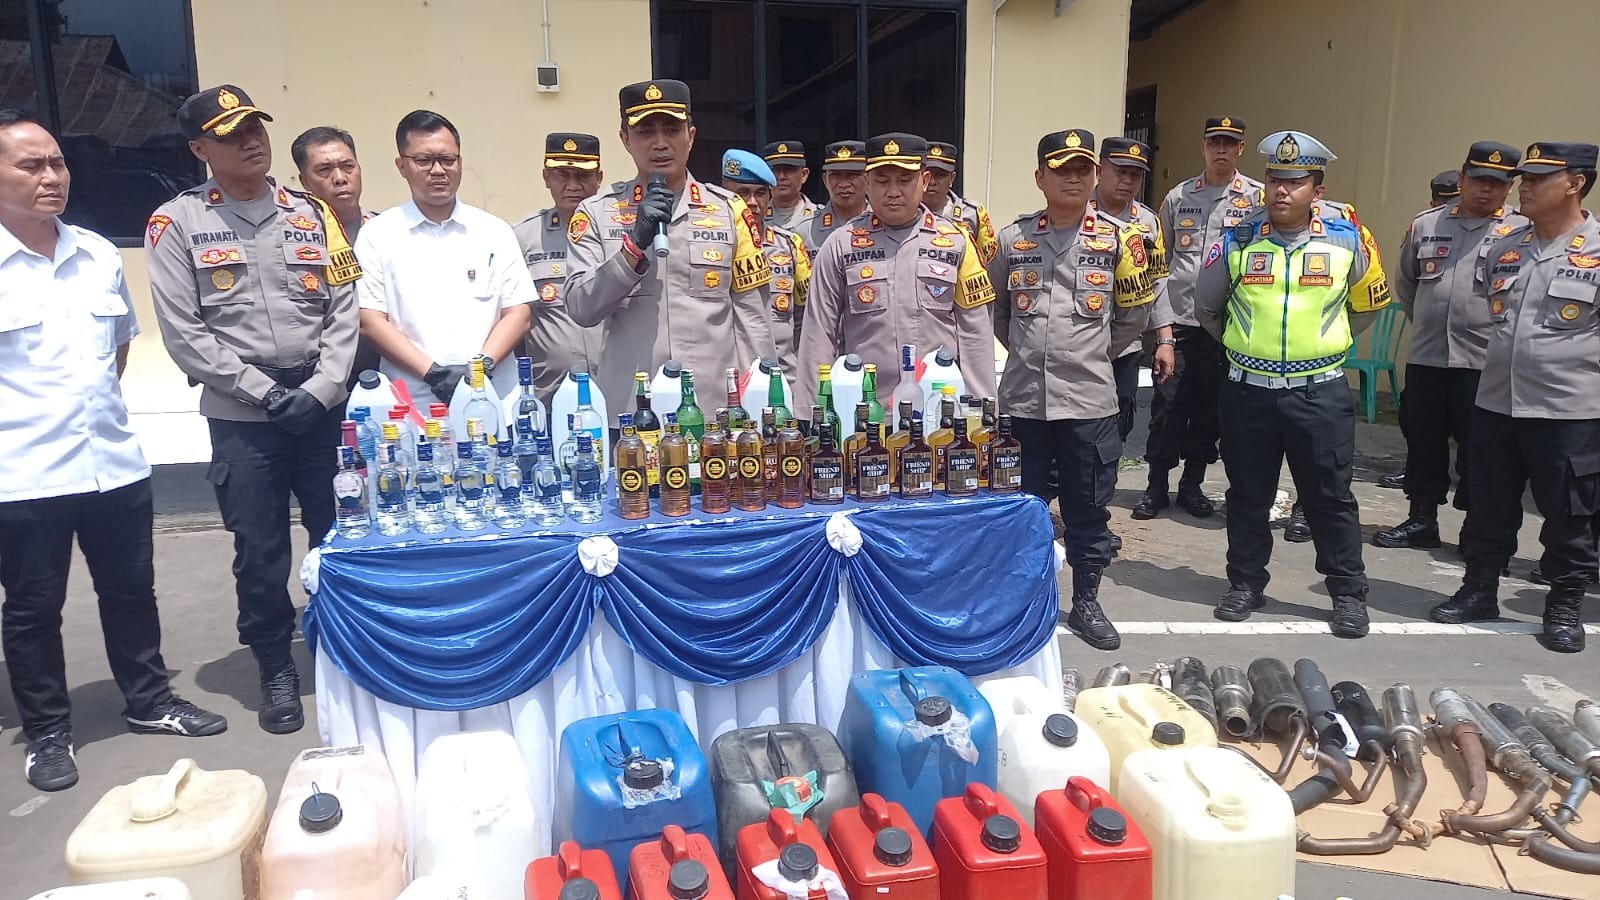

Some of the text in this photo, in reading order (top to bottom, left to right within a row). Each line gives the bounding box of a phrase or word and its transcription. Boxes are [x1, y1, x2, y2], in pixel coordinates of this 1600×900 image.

[190, 230, 239, 246] WIRANATA
[284, 230, 324, 245] POLRI
[692, 230, 729, 242] POLRI
[844, 249, 886, 263] TAUFAN
[918, 248, 959, 266] POLRI
[1078, 256, 1115, 266] POLRI
[734, 258, 755, 276] KA
[1556, 268, 1597, 281] POLRI
[965, 273, 988, 293] WAKA
[905, 461, 931, 470] FRIEND
[952, 458, 976, 466] FRIEND
[996, 456, 1020, 464] FRIEND
[1000, 461, 1017, 469] SHIP
[814, 466, 841, 474] FRIEND
[862, 463, 888, 472] FRIEND
